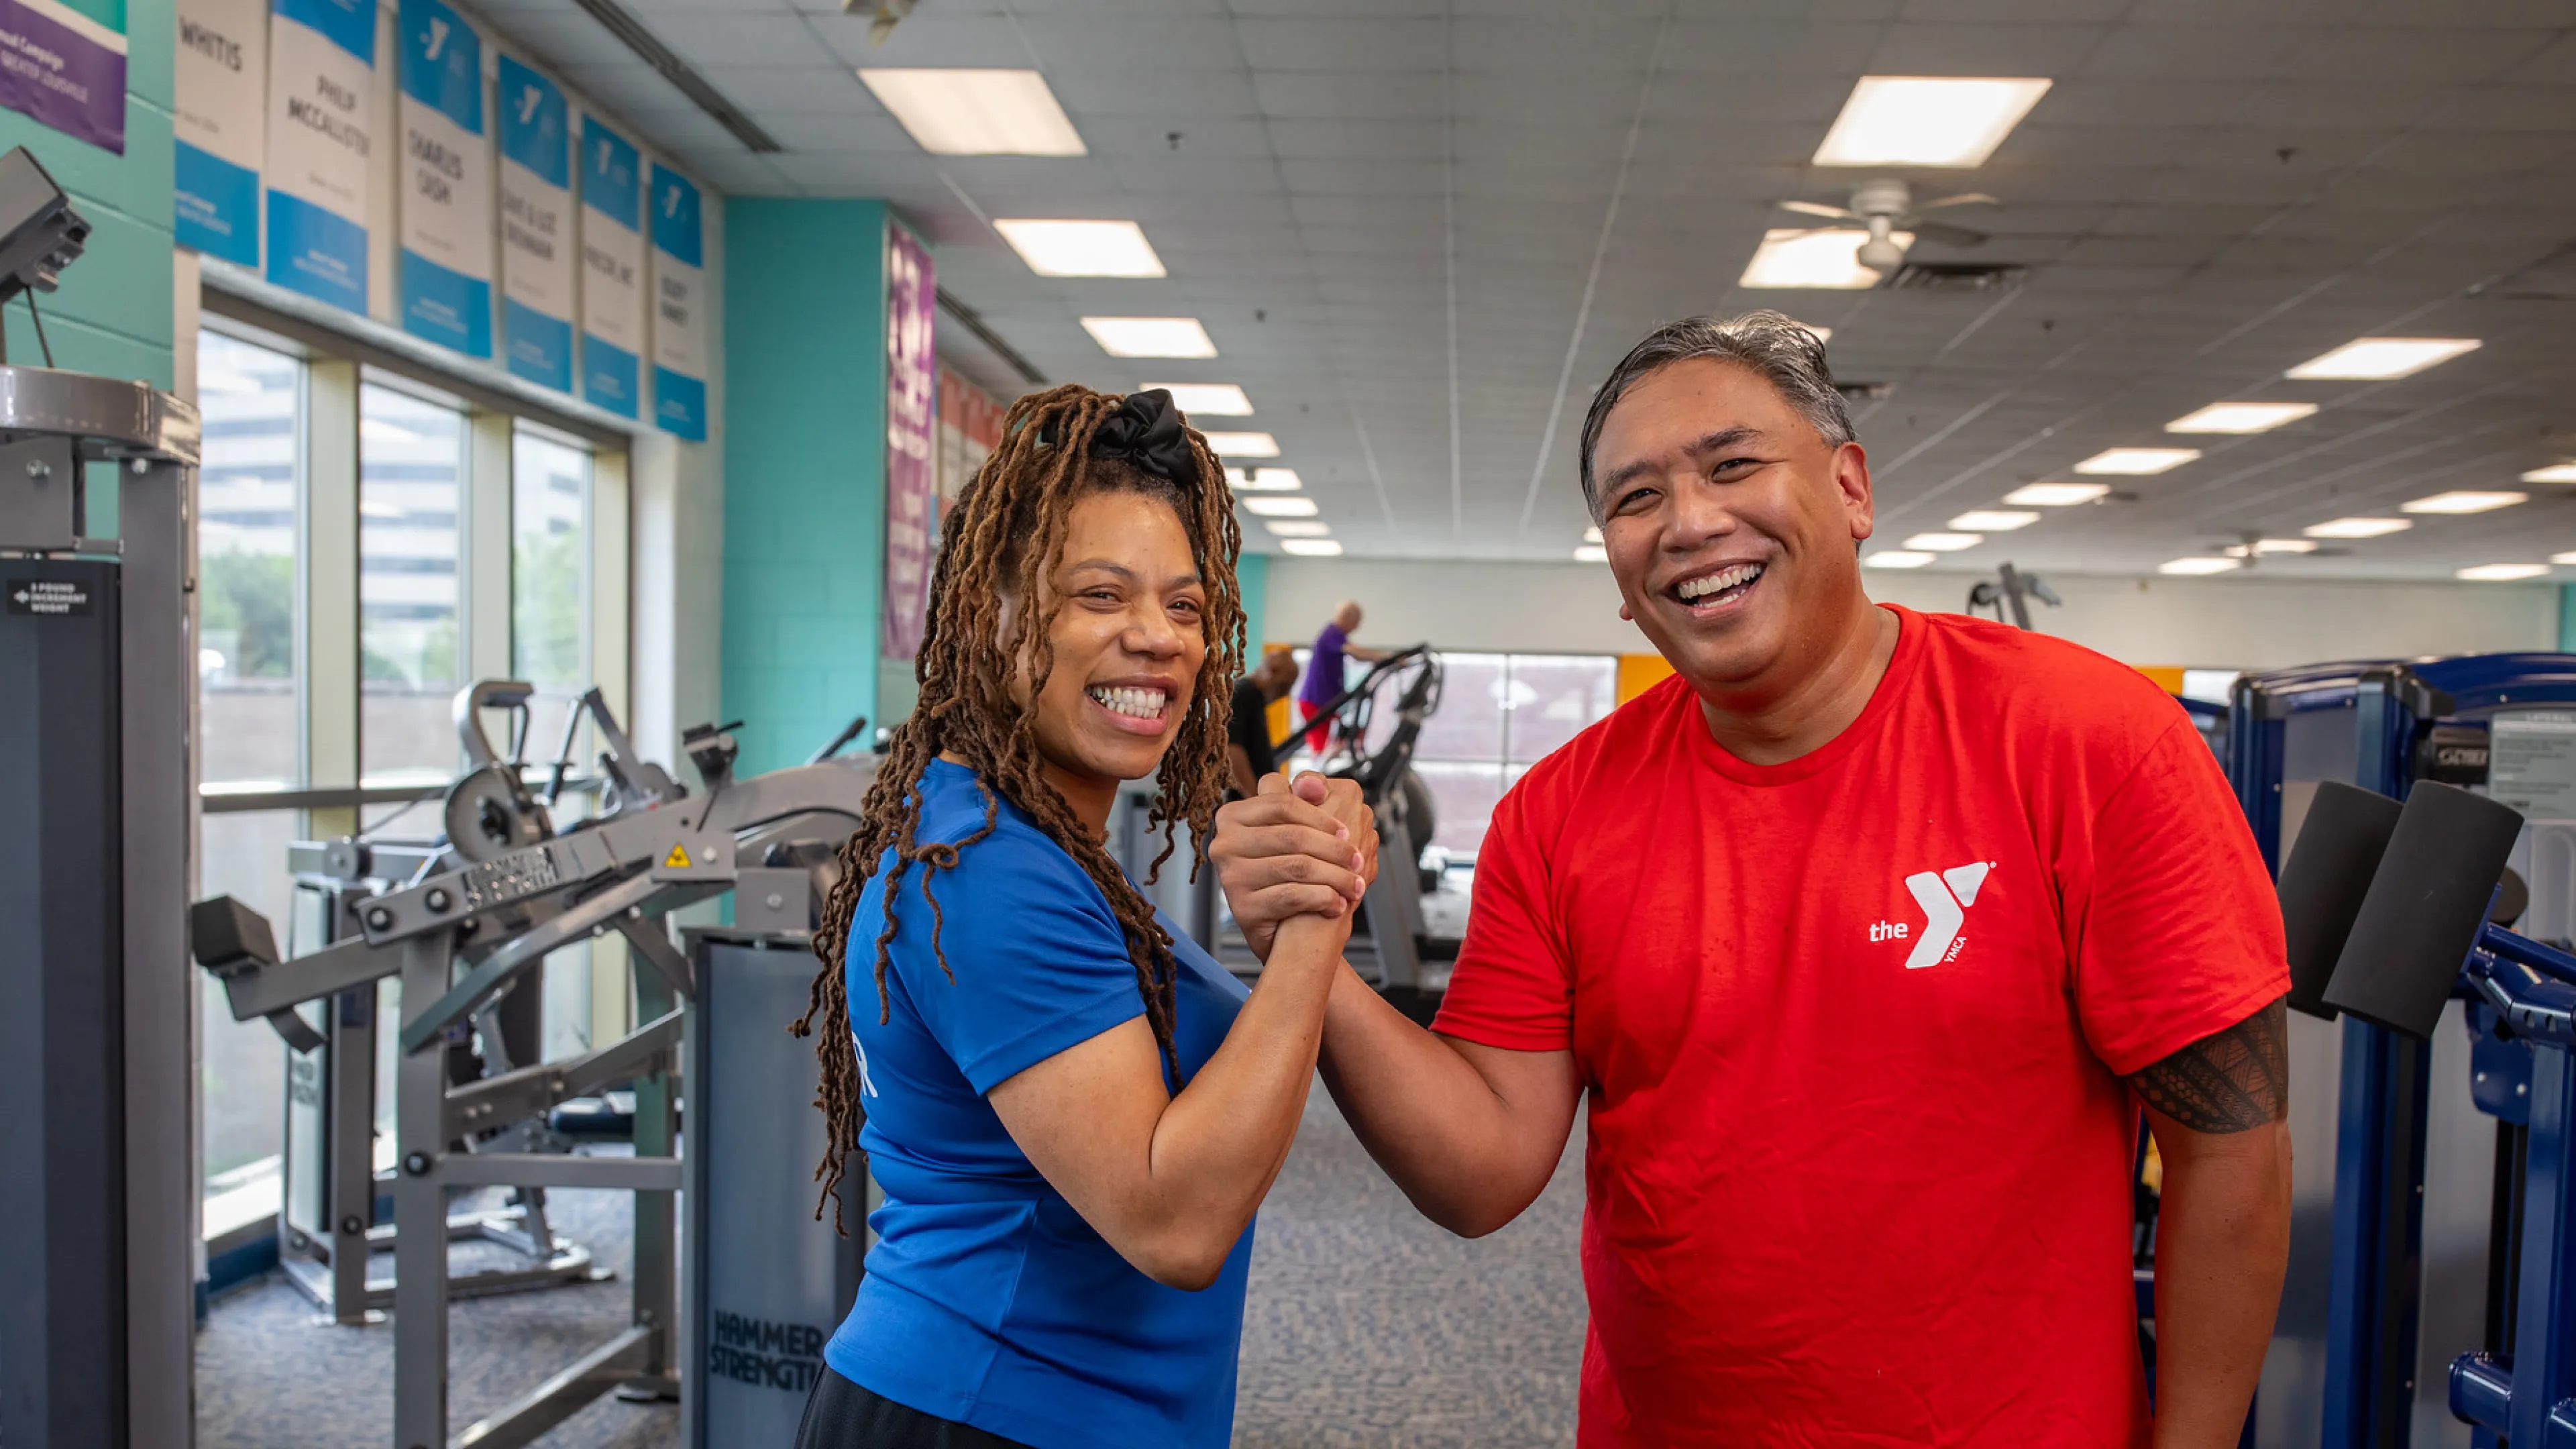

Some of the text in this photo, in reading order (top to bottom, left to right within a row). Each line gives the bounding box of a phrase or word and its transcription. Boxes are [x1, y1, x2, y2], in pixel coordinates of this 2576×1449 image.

[178, 14, 242, 73] WHITIS
[1870, 920, 1909, 942] the
[1944, 936, 1967, 963] YMCA
[714, 1309, 824, 1358] HAMMER
